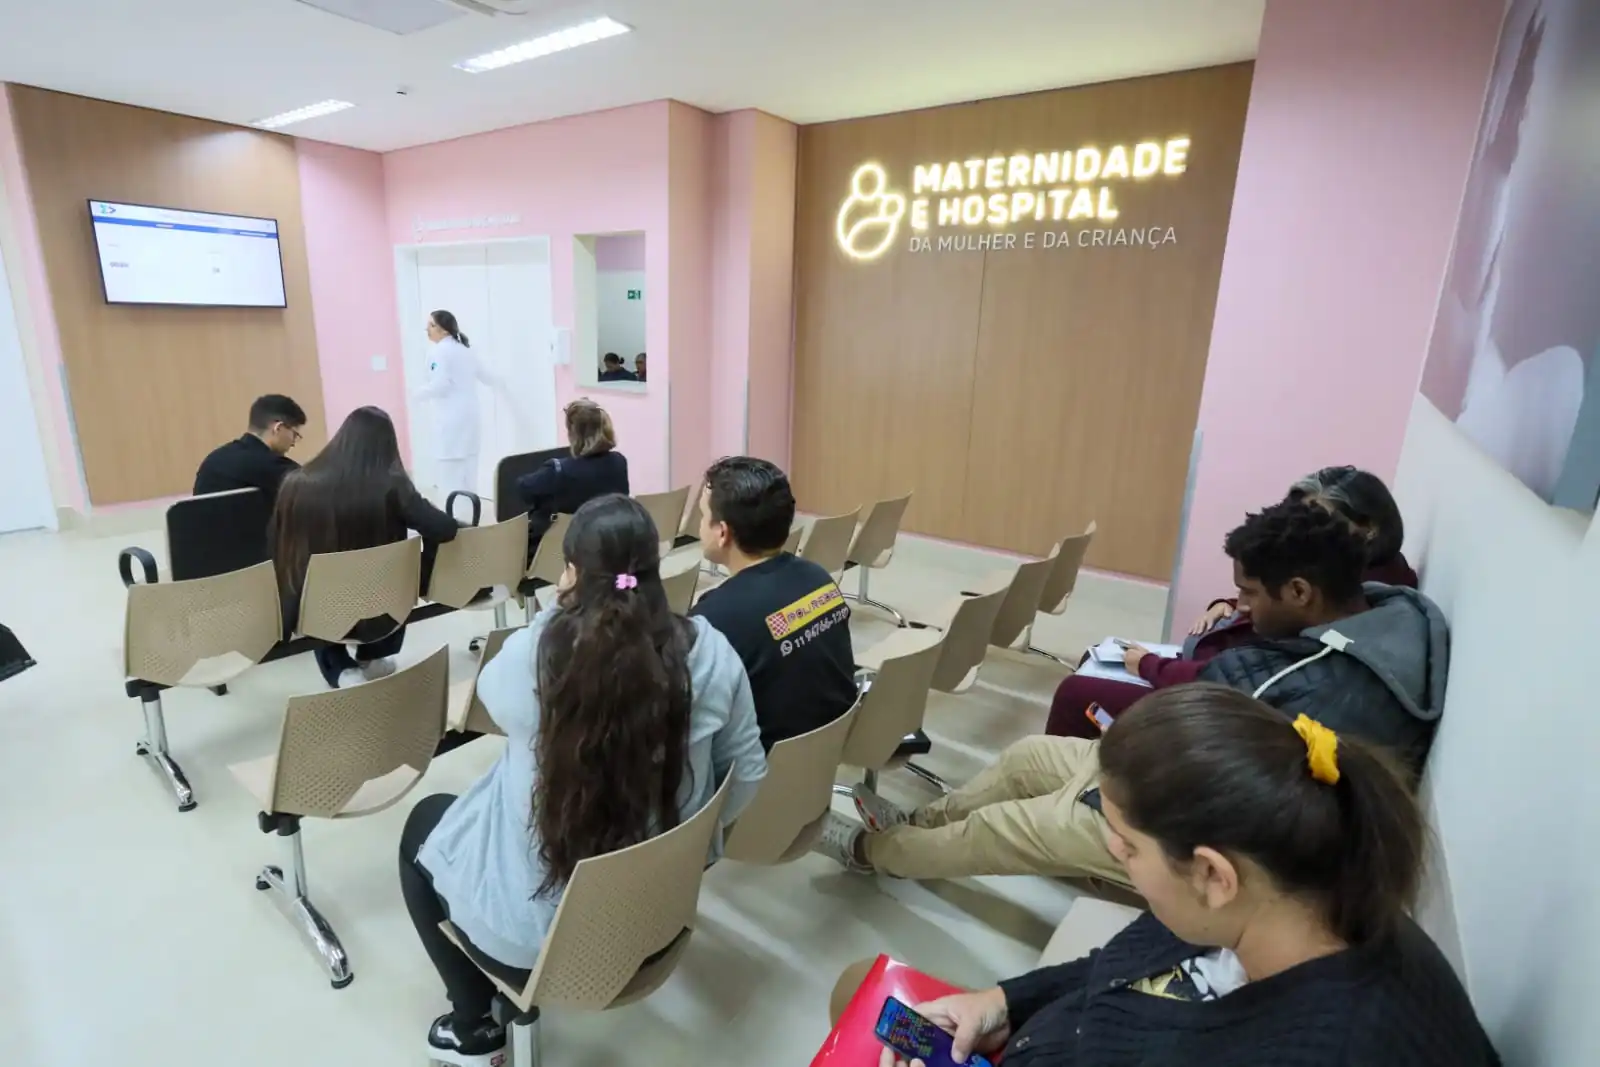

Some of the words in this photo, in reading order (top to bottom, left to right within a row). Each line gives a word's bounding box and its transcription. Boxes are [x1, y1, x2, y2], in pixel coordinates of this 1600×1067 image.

[912, 137, 1191, 194] MATERNIDADE
[910, 198, 930, 230] E
[938, 187, 1120, 227] HOSPITAL
[909, 236, 932, 252] DA
[938, 232, 1017, 251] MULHER
[1024, 231, 1035, 249] E
[1043, 230, 1070, 248] DA
[1078, 225, 1178, 249] CRIANÇA
[794, 636, 806, 648] 11
